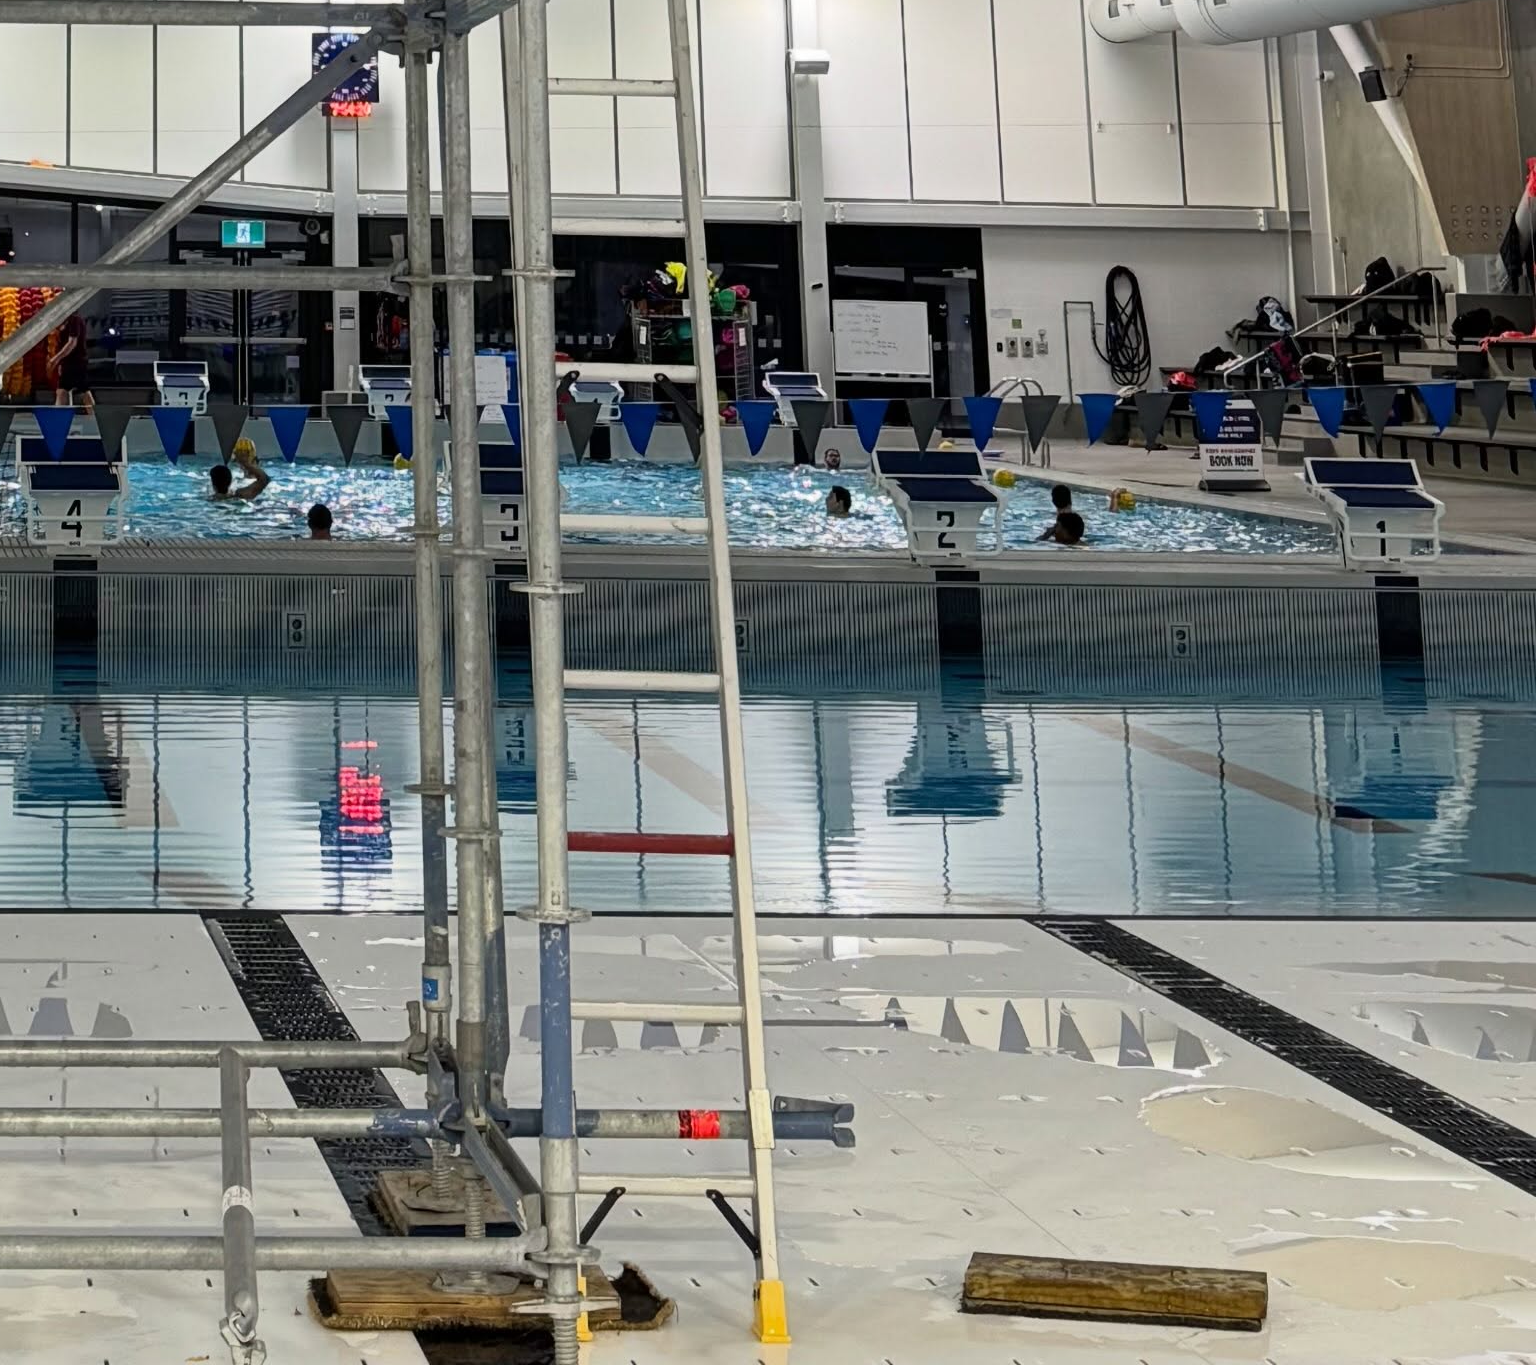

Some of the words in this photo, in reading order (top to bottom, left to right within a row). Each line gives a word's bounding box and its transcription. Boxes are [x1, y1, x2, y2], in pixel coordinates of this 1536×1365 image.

[1209, 455, 1233, 467] BOOK
[60, 499, 83, 538] 4
[500, 503, 519, 542] 3
[936, 510, 956, 549] 2
[1375, 520, 1387, 557] 1
